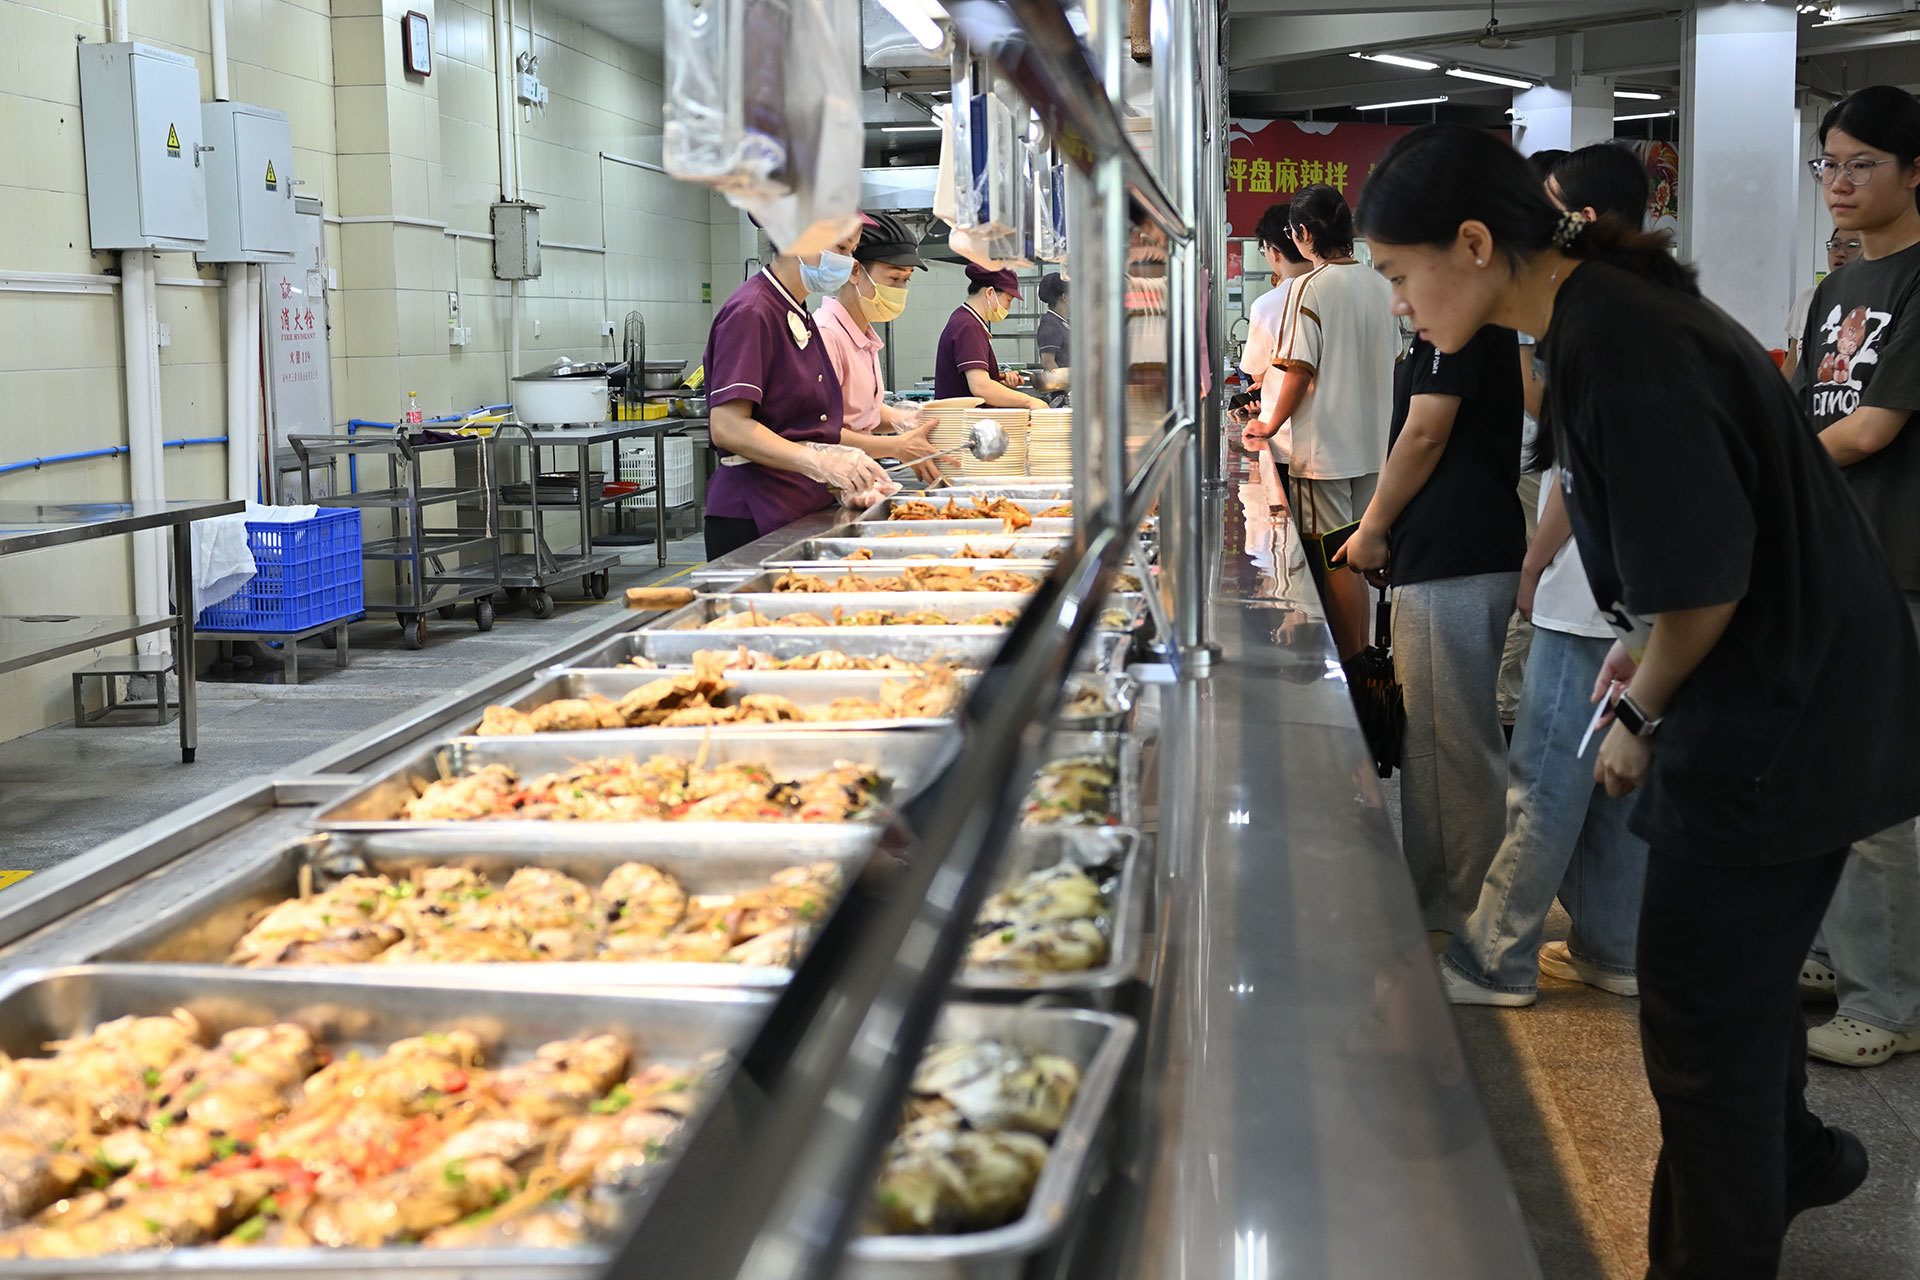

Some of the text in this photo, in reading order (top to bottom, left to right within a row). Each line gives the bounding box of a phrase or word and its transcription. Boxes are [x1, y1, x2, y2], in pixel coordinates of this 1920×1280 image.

[281, 307, 315, 331] 消火栓
[294, 333, 316, 341] HYDRANT
